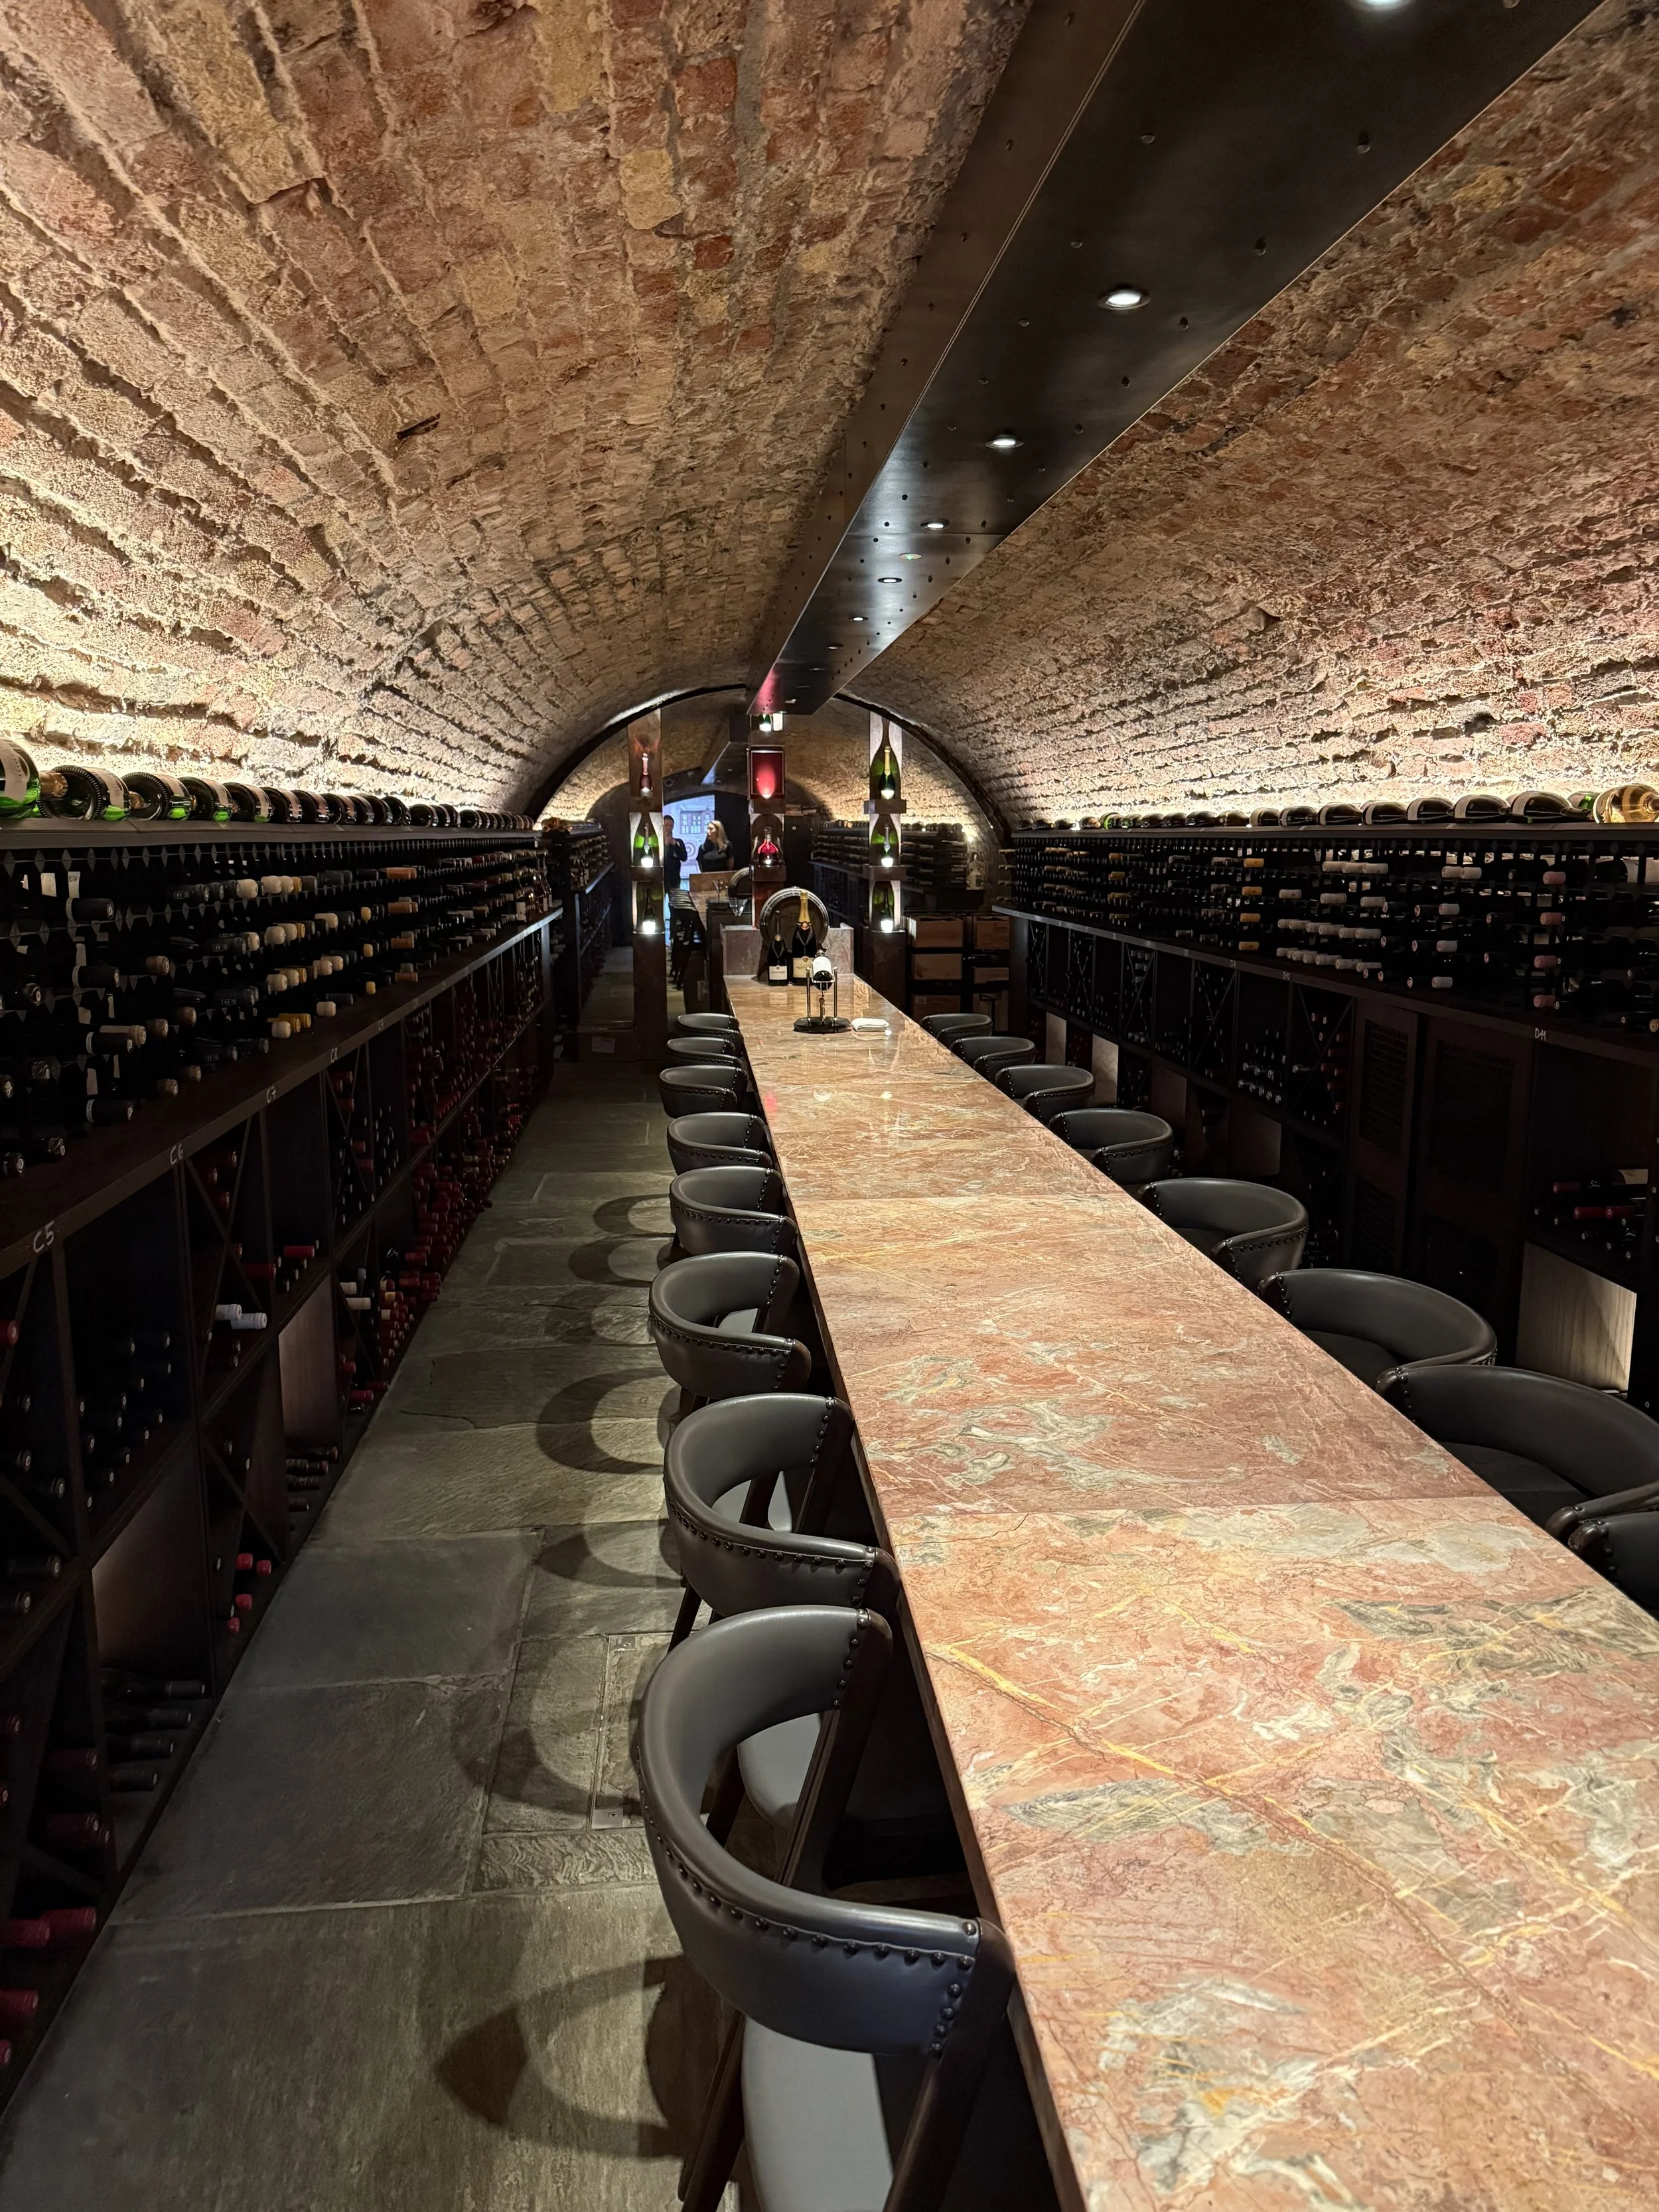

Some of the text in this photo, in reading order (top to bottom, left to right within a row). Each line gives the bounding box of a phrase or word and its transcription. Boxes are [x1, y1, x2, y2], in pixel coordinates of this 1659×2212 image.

[1535, 1027, 1546, 1041] D11
[267, 1086, 276, 1103] C7
[170, 1143, 184, 1165] C6
[33, 1220, 54, 1253] C5
